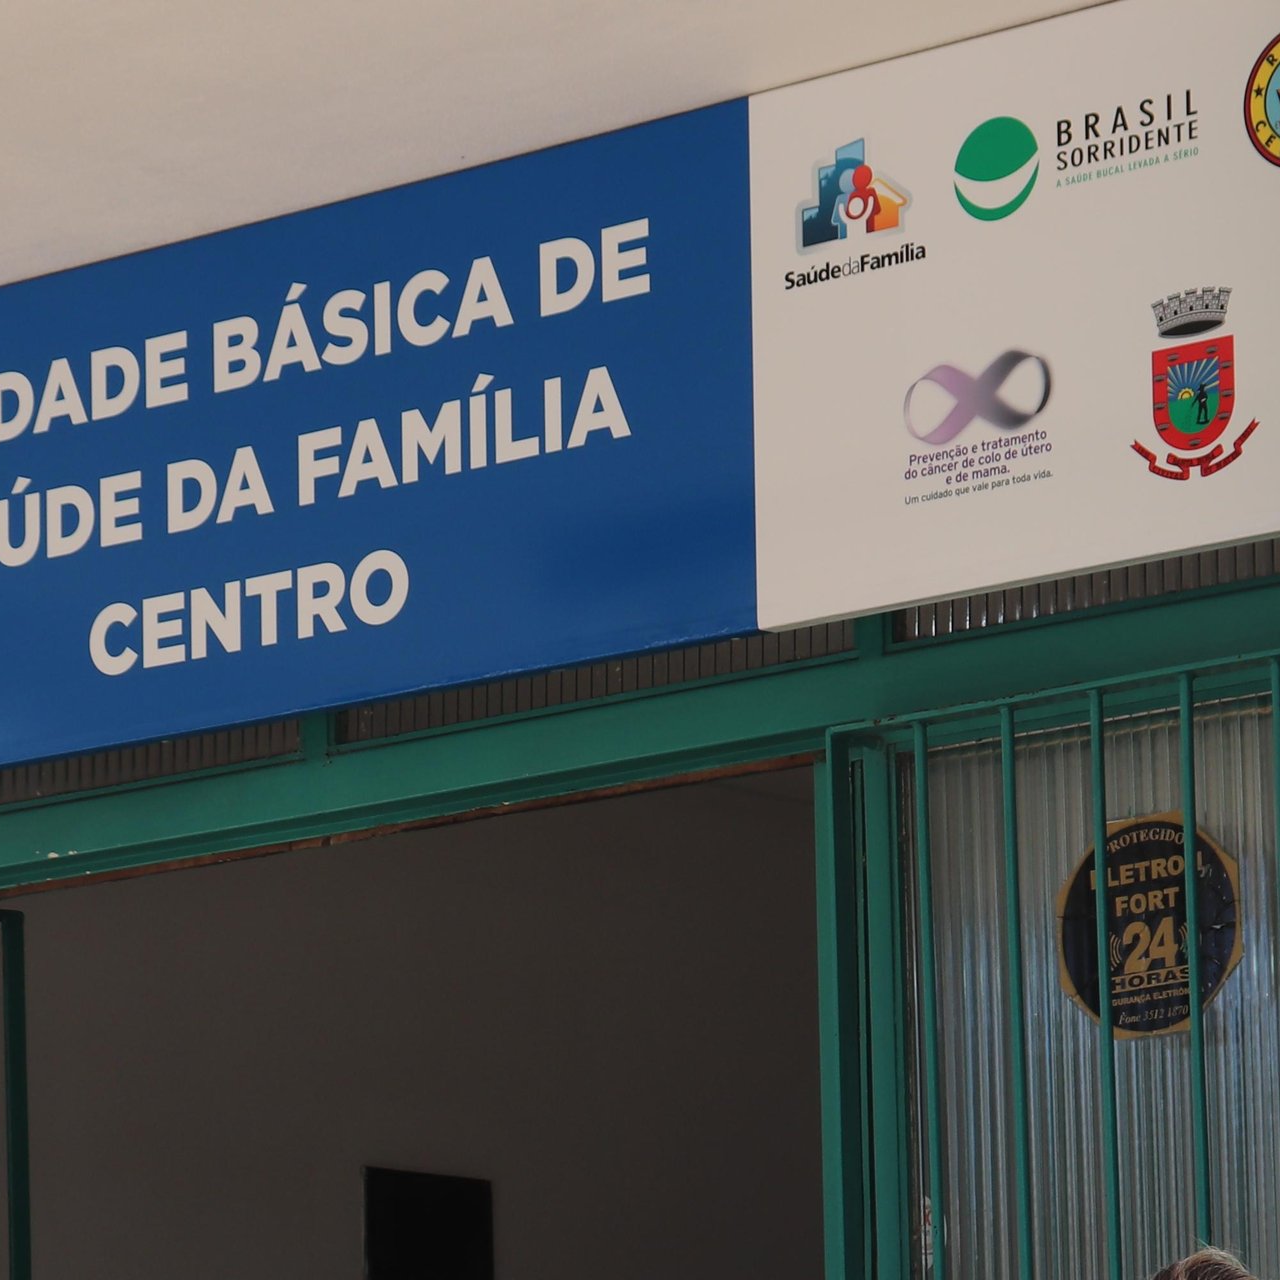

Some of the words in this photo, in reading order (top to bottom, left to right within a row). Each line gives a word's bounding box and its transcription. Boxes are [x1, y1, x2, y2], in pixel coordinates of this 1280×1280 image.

[1056, 89, 1198, 147] BRASIL
[1056, 119, 1198, 171] SORRIDENTE
[1056, 179, 1061, 188] A
[1065, 170, 1093, 186] SAÚDE
[1096, 164, 1124, 179] BUCAL
[1128, 156, 1161, 172] LEVADA
[1163, 155, 1170, 163] A
[1173, 147, 1199, 161] SÉRIO
[213, 257, 514, 394] BÁSICA
[539, 218, 651, 317] DE
[166, 445, 275, 534] DA
[297, 366, 632, 507] FAMÍLIA
[904, 468, 918, 480] do
[920, 460, 959, 477] câncer
[961, 457, 975, 469] de
[978, 452, 1001, 466] colo
[1004, 448, 1018, 460] de
[1021, 442, 1052, 457] útero
[909, 444, 969, 466] Prevenção
[971, 445, 978, 454] e
[981, 429, 1047, 452] tratamento
[904, 495, 919, 505] Um
[921, 488, 953, 503] cuidado
[955, 485, 970, 498] que
[972, 482, 989, 493] vale
[991, 478, 1010, 490] para
[1012, 474, 1031, 485] toda
[1033, 469, 1053, 481] vida.
[945, 475, 952, 485] e
[955, 472, 969, 483] de
[972, 464, 1010, 480] mama.
[89, 549, 410, 676] CENTRO
[1106, 827, 1185, 854] ROTEGIDO
[1115, 886, 1180, 917] FORT
[1123, 916, 1179, 976] 24
[1112, 967, 1190, 991] HORAS
